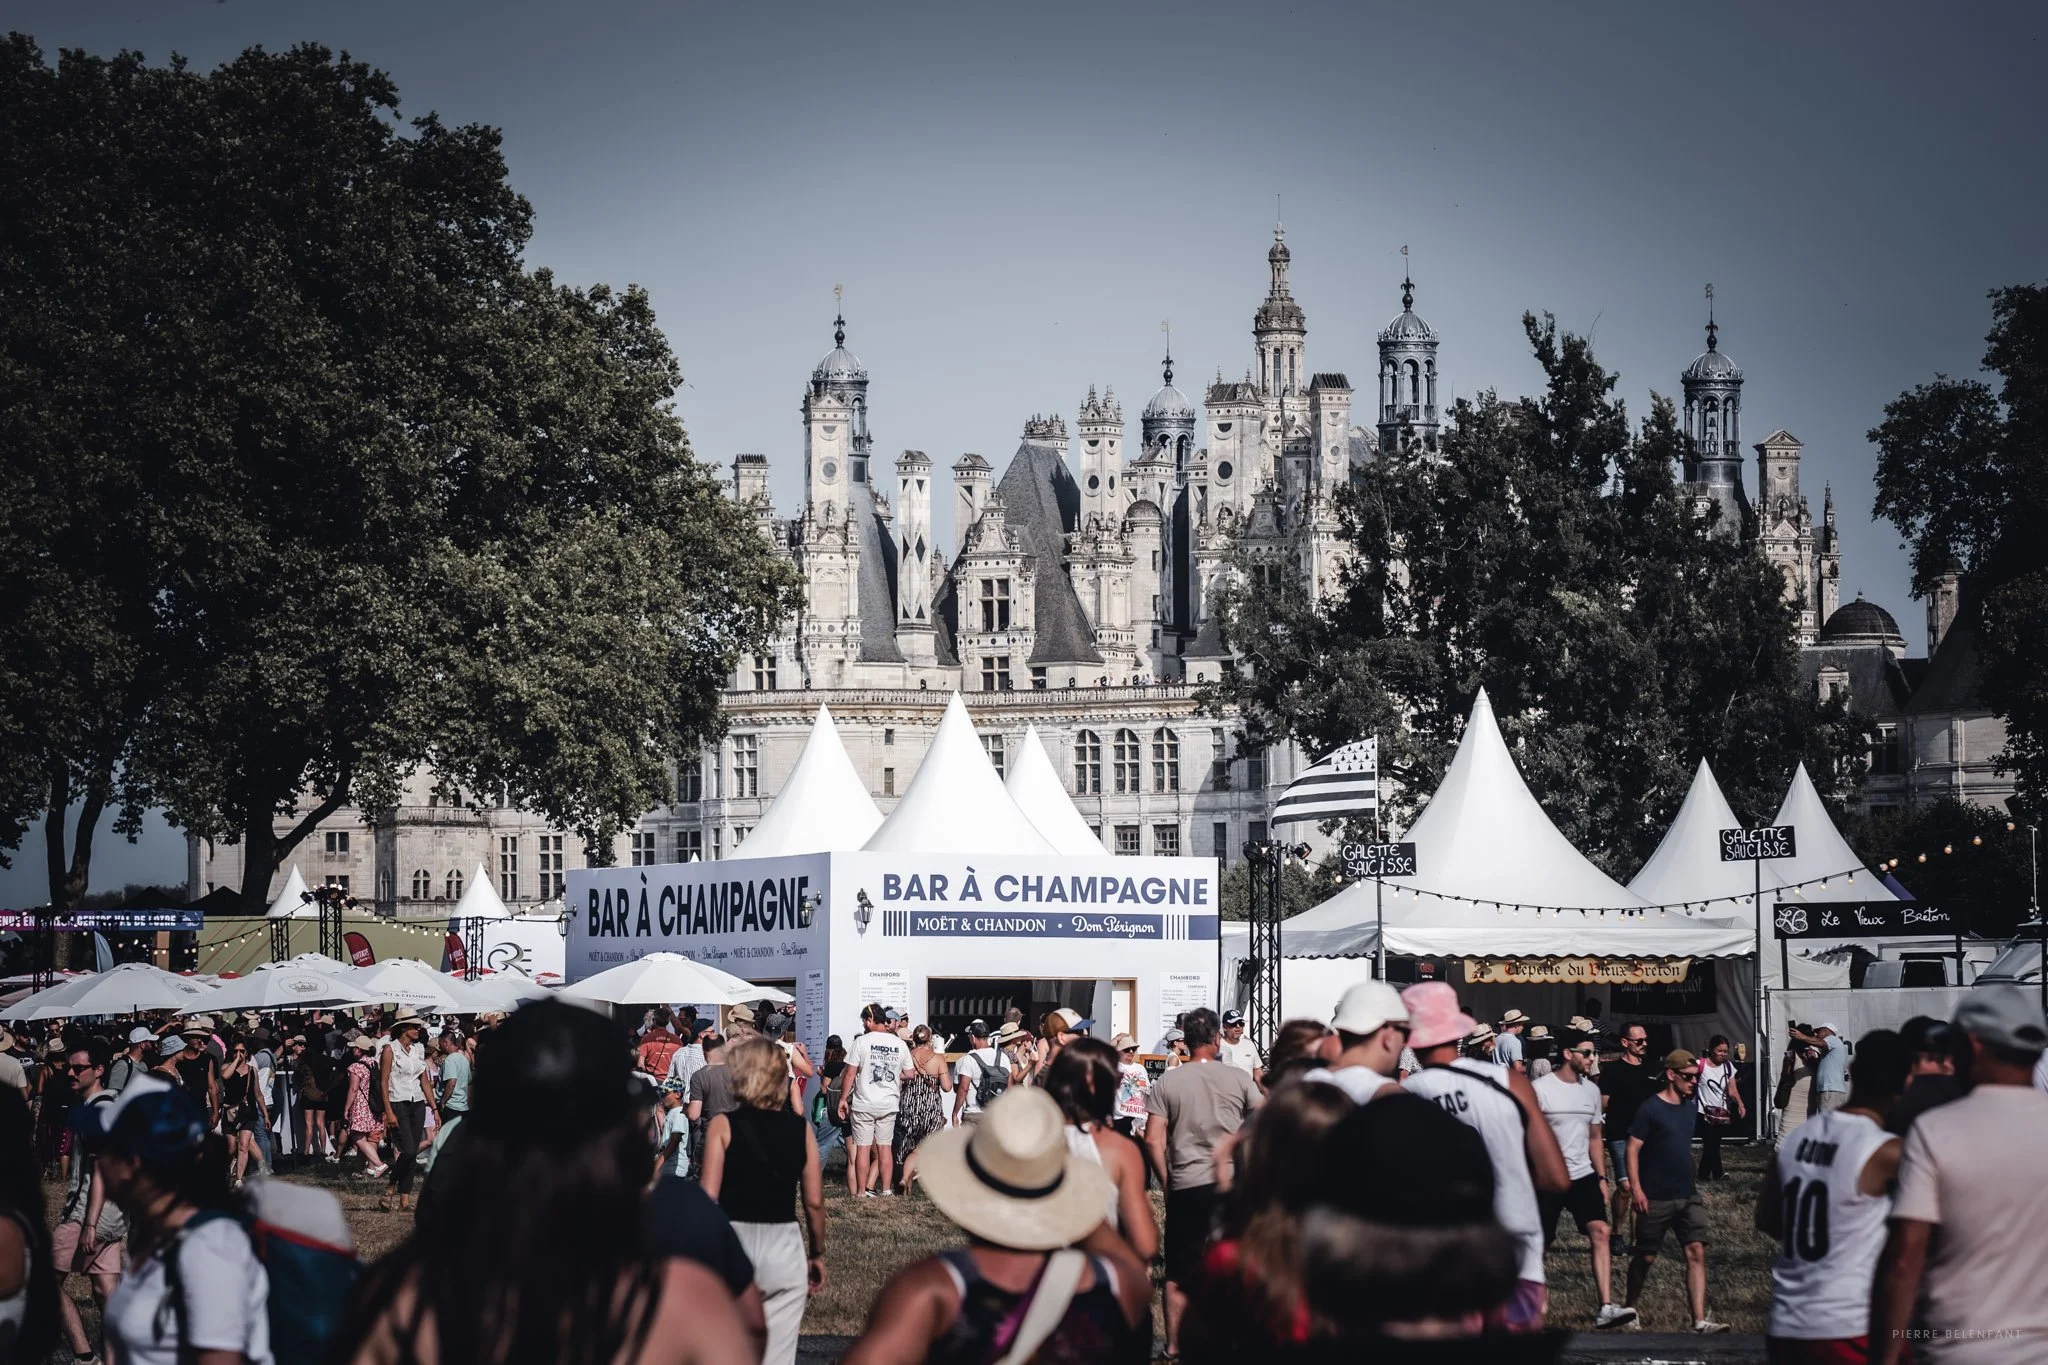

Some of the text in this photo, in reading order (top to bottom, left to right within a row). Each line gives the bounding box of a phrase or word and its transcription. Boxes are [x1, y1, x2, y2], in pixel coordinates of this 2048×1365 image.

[1722, 827, 1787, 845] GALETTE
[1342, 844, 1400, 861] GALETTE
[1725, 841, 1791, 861] SAUCISSE
[883, 865, 1208, 905] BAR À CHAMPAGNE
[588, 872, 809, 937] BAR À CHAMPAGNE
[134, 915, 146, 927] DE
[916, 915, 1156, 938] MOËT & CHANDON Dom Pérignon
[1821, 910, 1840, 927] Le
[1854, 906, 1885, 927] Vieux
[1900, 906, 1950, 925] Breton
[1567, 962, 1585, 976] du
[1589, 961, 1627, 977] Vieux
[1631, 962, 1681, 978] Breton
[870, 1045, 900, 1054] MIDDLE
[1784, 1175, 1830, 1262] 10
